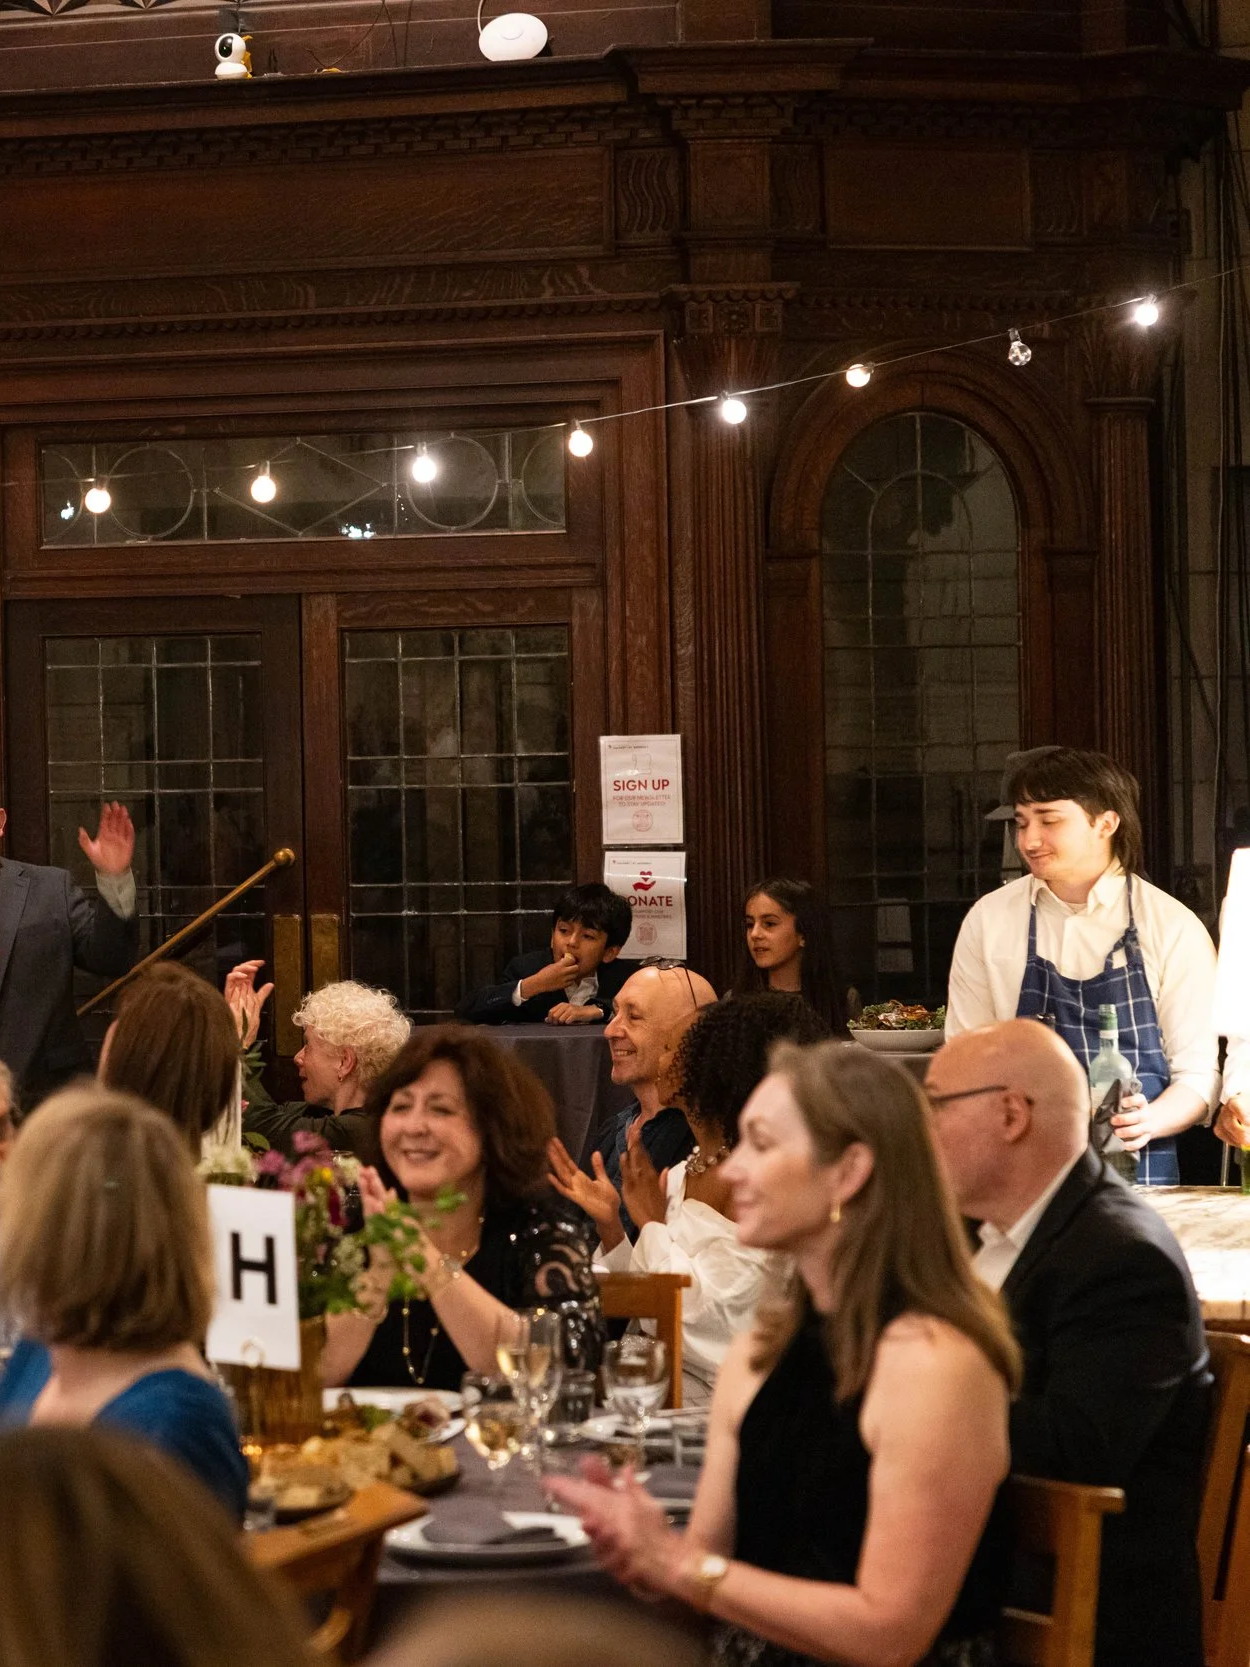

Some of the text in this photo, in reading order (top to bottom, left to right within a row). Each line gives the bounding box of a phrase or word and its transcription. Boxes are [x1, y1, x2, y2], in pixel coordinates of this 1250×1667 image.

[613, 779, 670, 792] SIGN UP
[627, 895, 673, 907] ONATE
[231, 1231, 277, 1305] H
